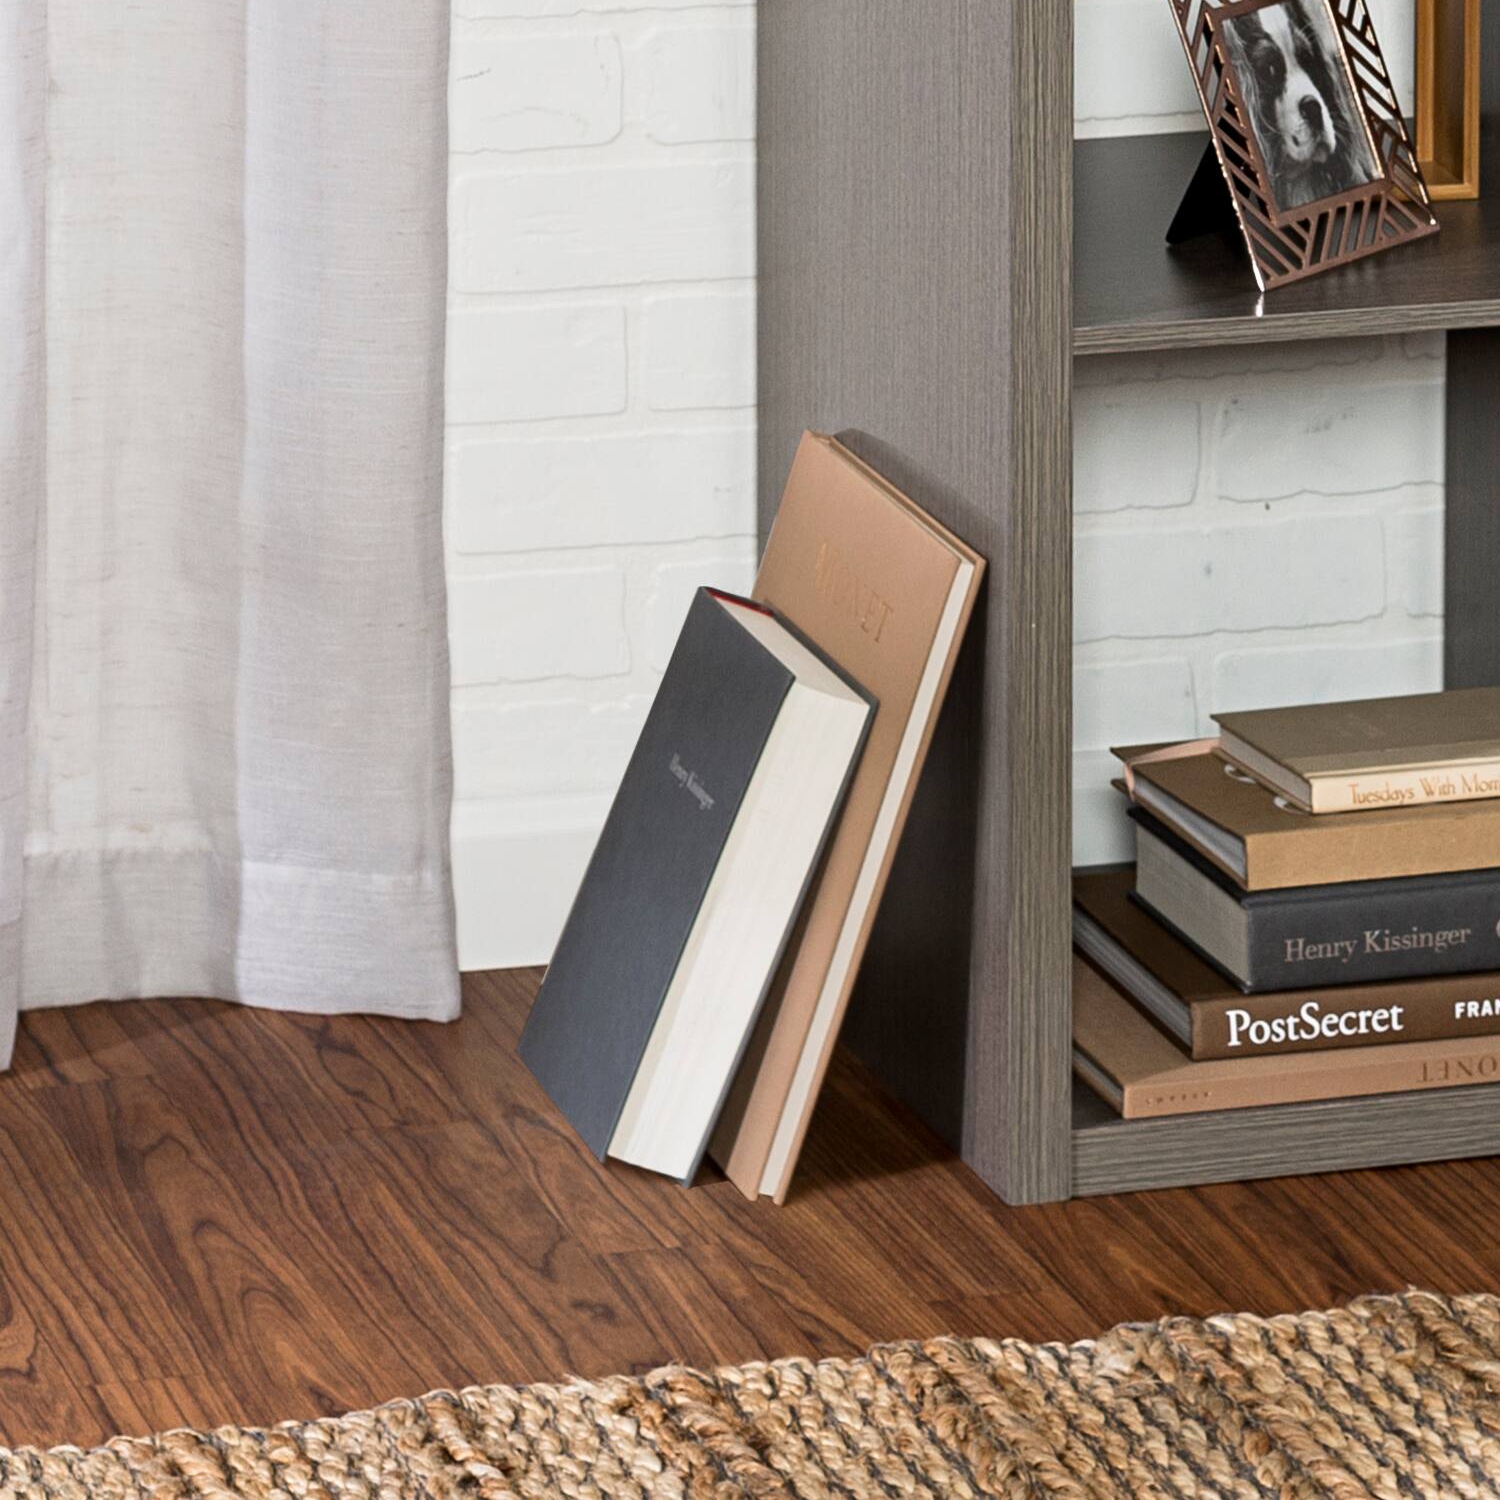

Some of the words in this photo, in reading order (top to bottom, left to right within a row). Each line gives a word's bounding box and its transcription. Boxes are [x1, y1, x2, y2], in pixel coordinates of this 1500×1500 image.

[1348, 783, 1415, 807] Tuesdays
[1419, 776, 1457, 798] With
[1283, 937, 1358, 964] Henry
[1363, 926, 1472, 954] Kissinger
[1225, 1001, 1405, 1048] PostSecret
